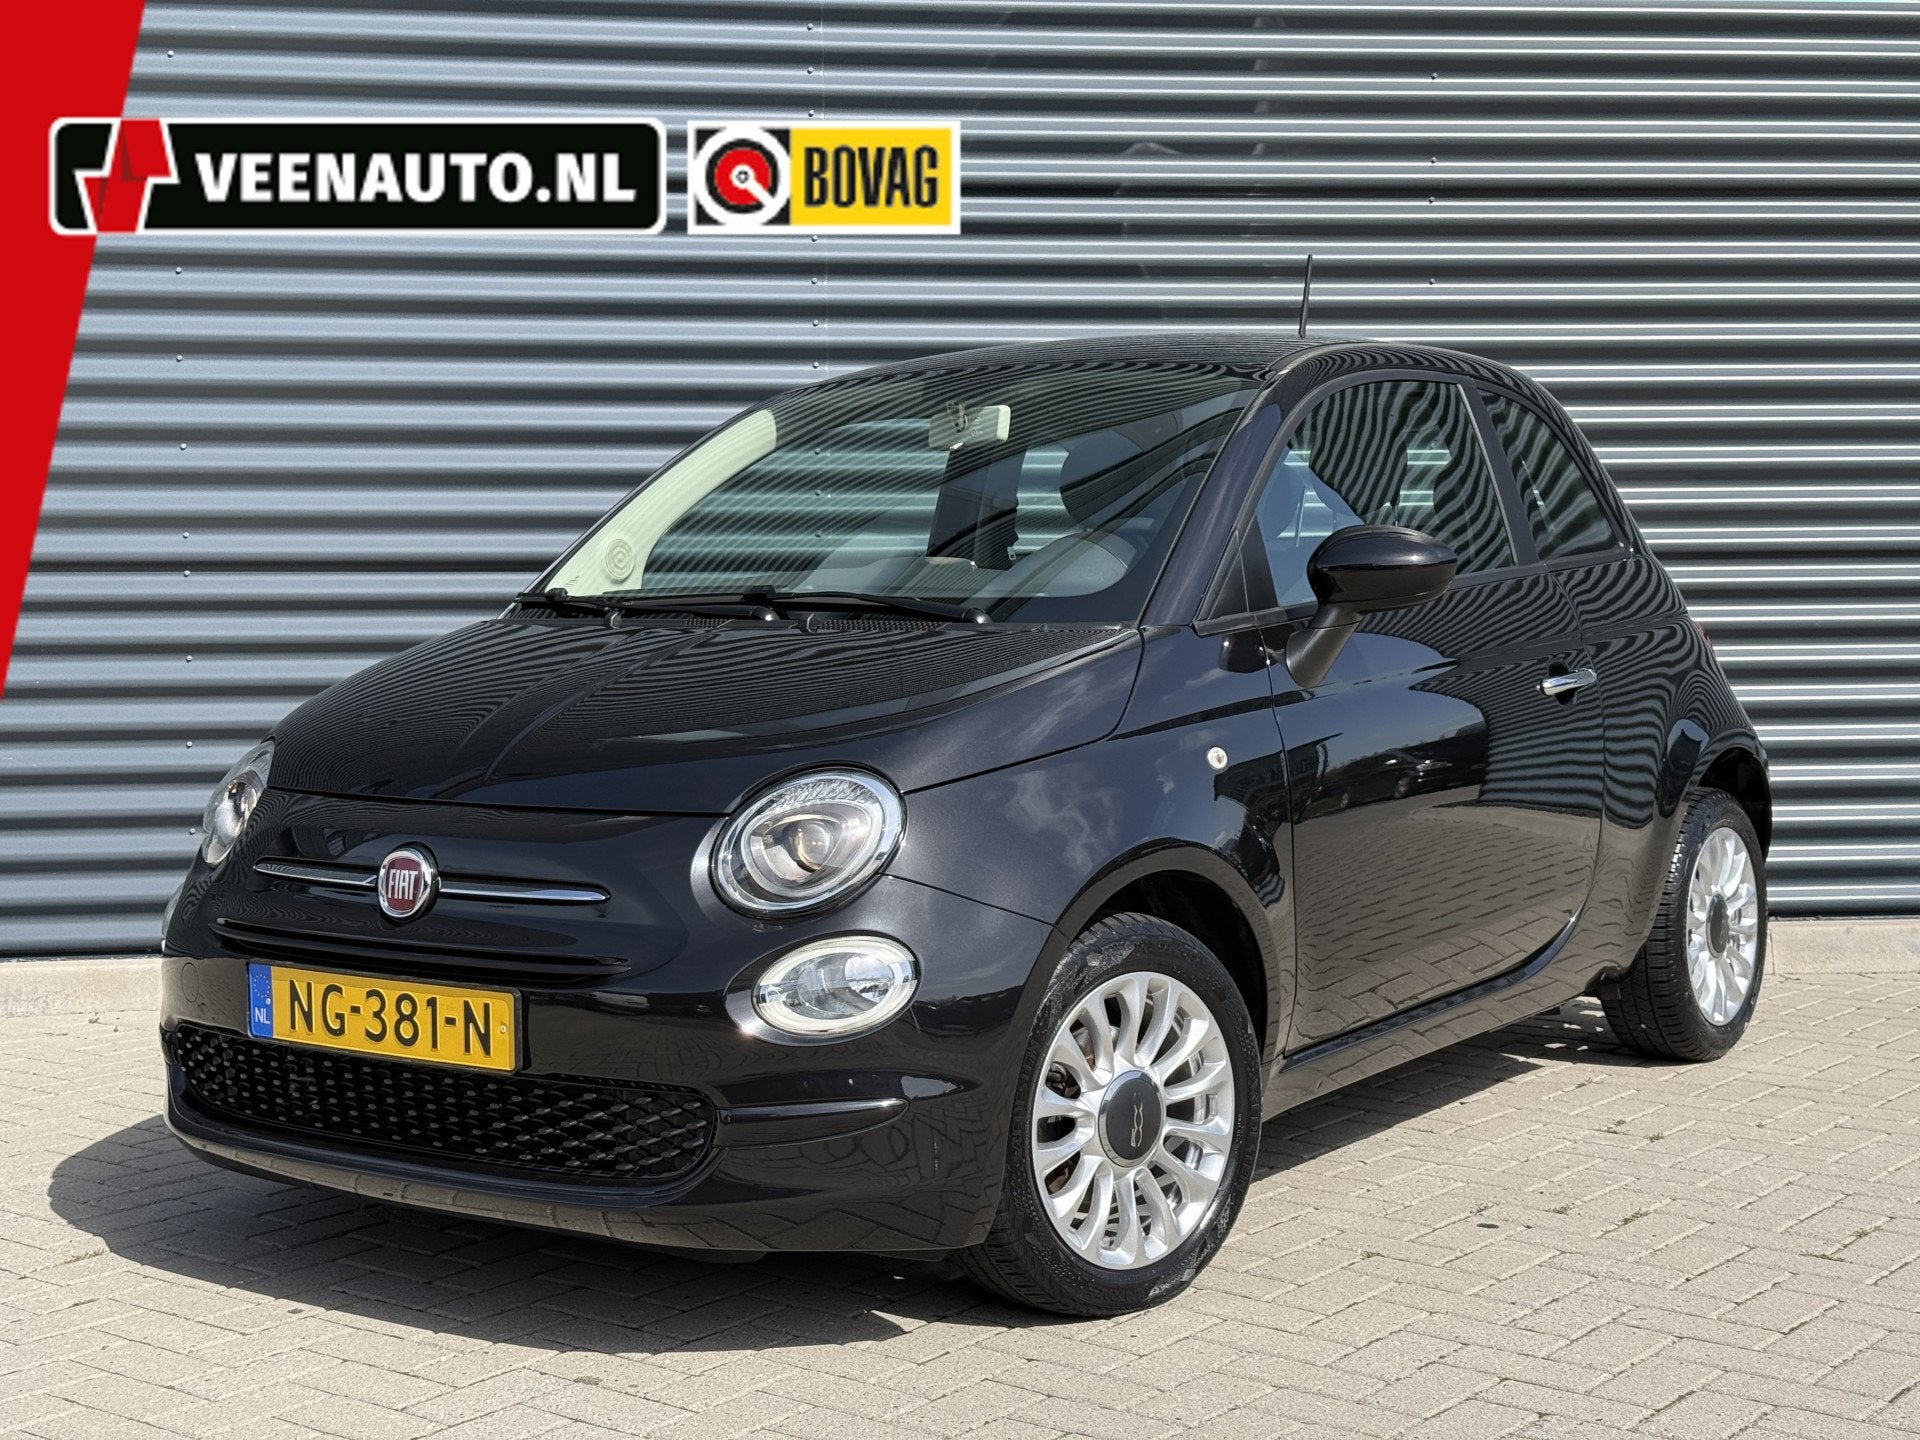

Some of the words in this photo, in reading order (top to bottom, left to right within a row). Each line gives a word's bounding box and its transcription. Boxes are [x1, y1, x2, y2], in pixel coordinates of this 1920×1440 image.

[387, 868, 419, 901] FIAT
[254, 1007, 271, 1025] NL
[289, 979, 492, 1057] NG-381-N
